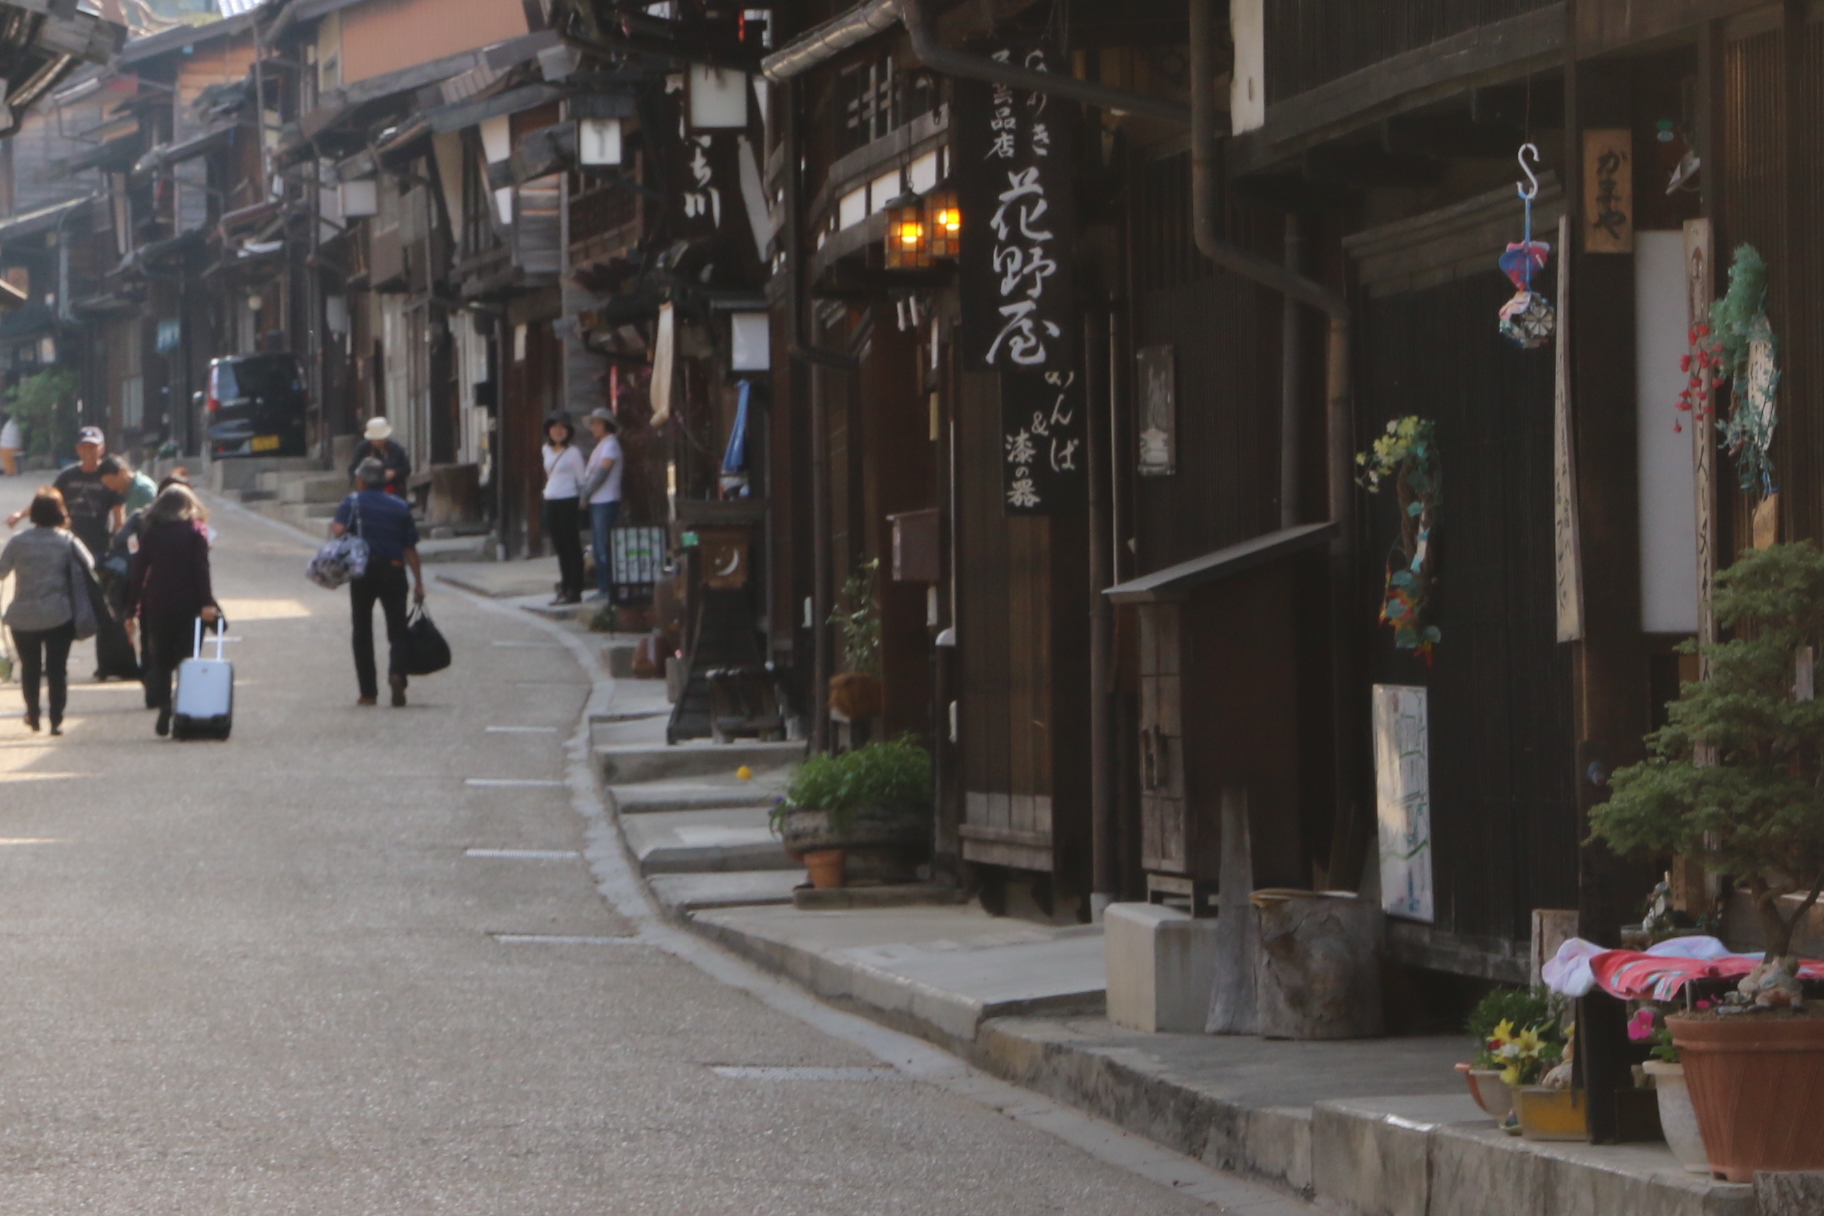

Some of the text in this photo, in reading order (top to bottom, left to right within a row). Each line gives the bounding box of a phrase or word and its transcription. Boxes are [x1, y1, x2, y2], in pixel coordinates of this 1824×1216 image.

[985, 167, 1061, 365] 花野屋
[1004, 427, 1042, 508] 漆の器
